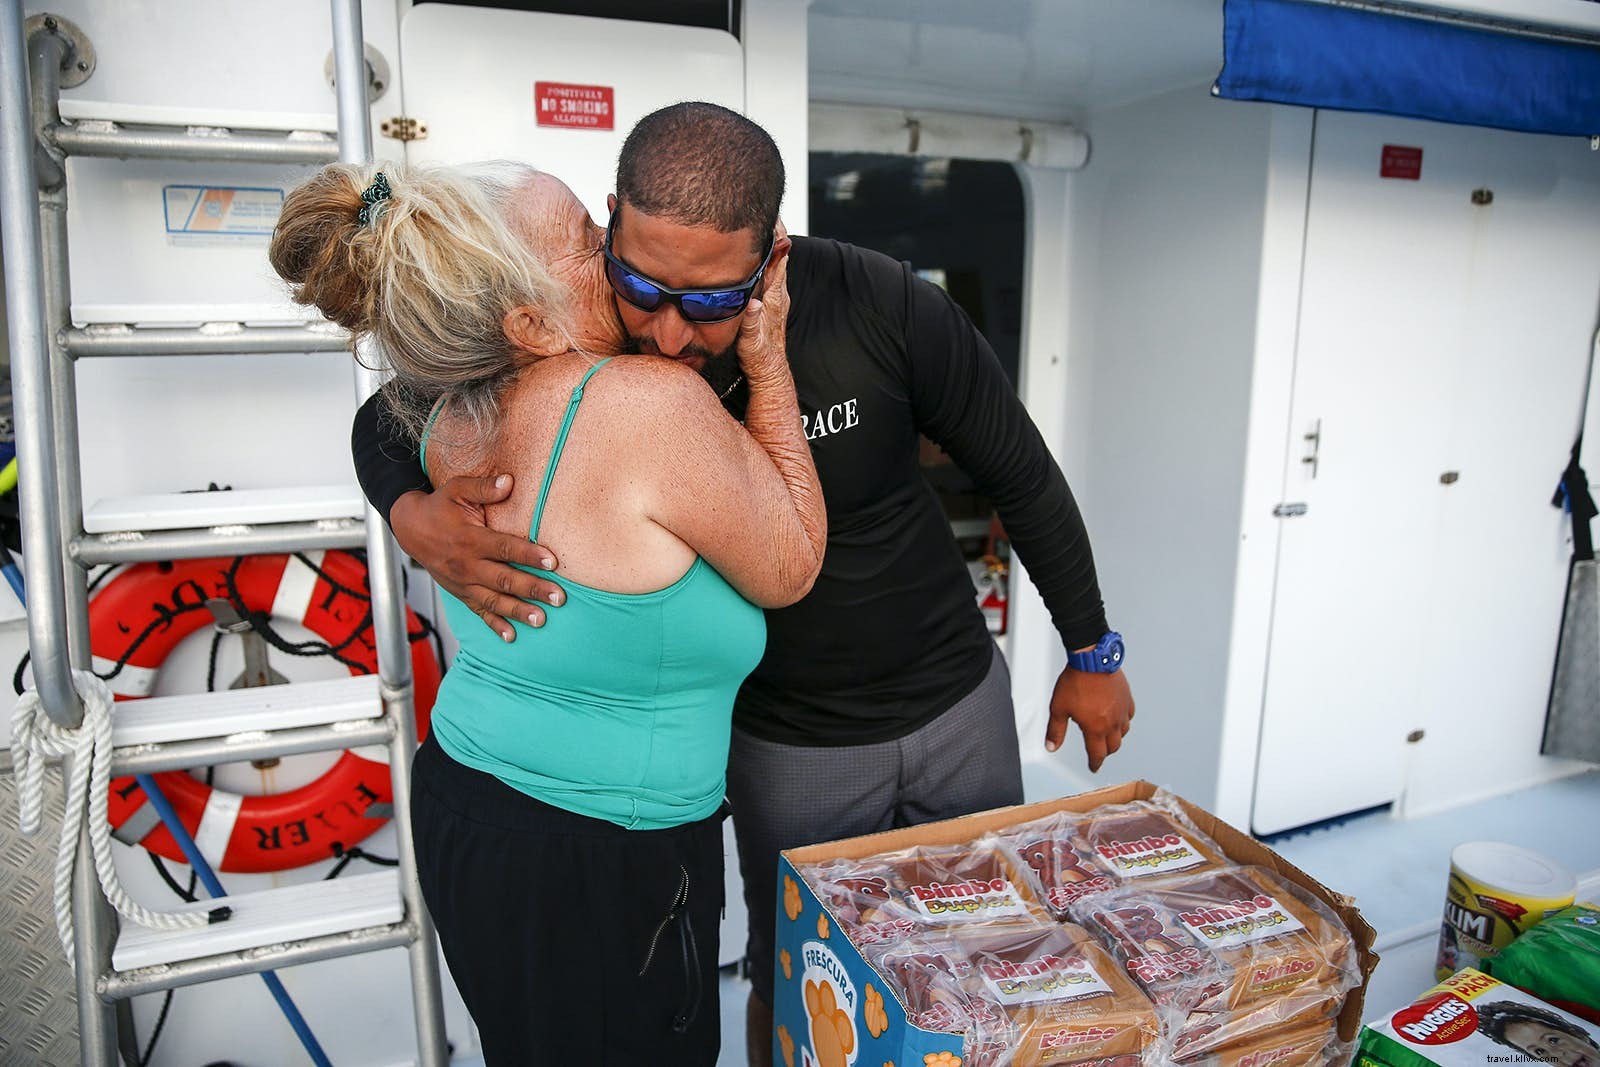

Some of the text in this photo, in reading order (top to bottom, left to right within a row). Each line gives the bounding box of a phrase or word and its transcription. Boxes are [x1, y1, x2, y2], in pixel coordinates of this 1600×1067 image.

[547, 87, 603, 99] POSITIVELY
[541, 98, 609, 115] NO SMOKING
[552, 114, 598, 124] ALLOWED
[1096, 834, 1181, 859] bimbo
[1112, 846, 1193, 869] Duplex
[910, 878, 1008, 901] bimbo
[924, 894, 1017, 914] Duplex
[1178, 894, 1274, 928] bimbo
[1199, 910, 1289, 940] Duplex
[805, 949, 854, 1009] FRESCURA
[980, 954, 1086, 981] bimbo
[1252, 960, 1316, 984] bimbo
[996, 970, 1098, 995] Duplex
[1457, 975, 1498, 996] PACK
[1400, 998, 1470, 1041] HUGGIES
[1039, 1026, 1118, 1050] bimbo
